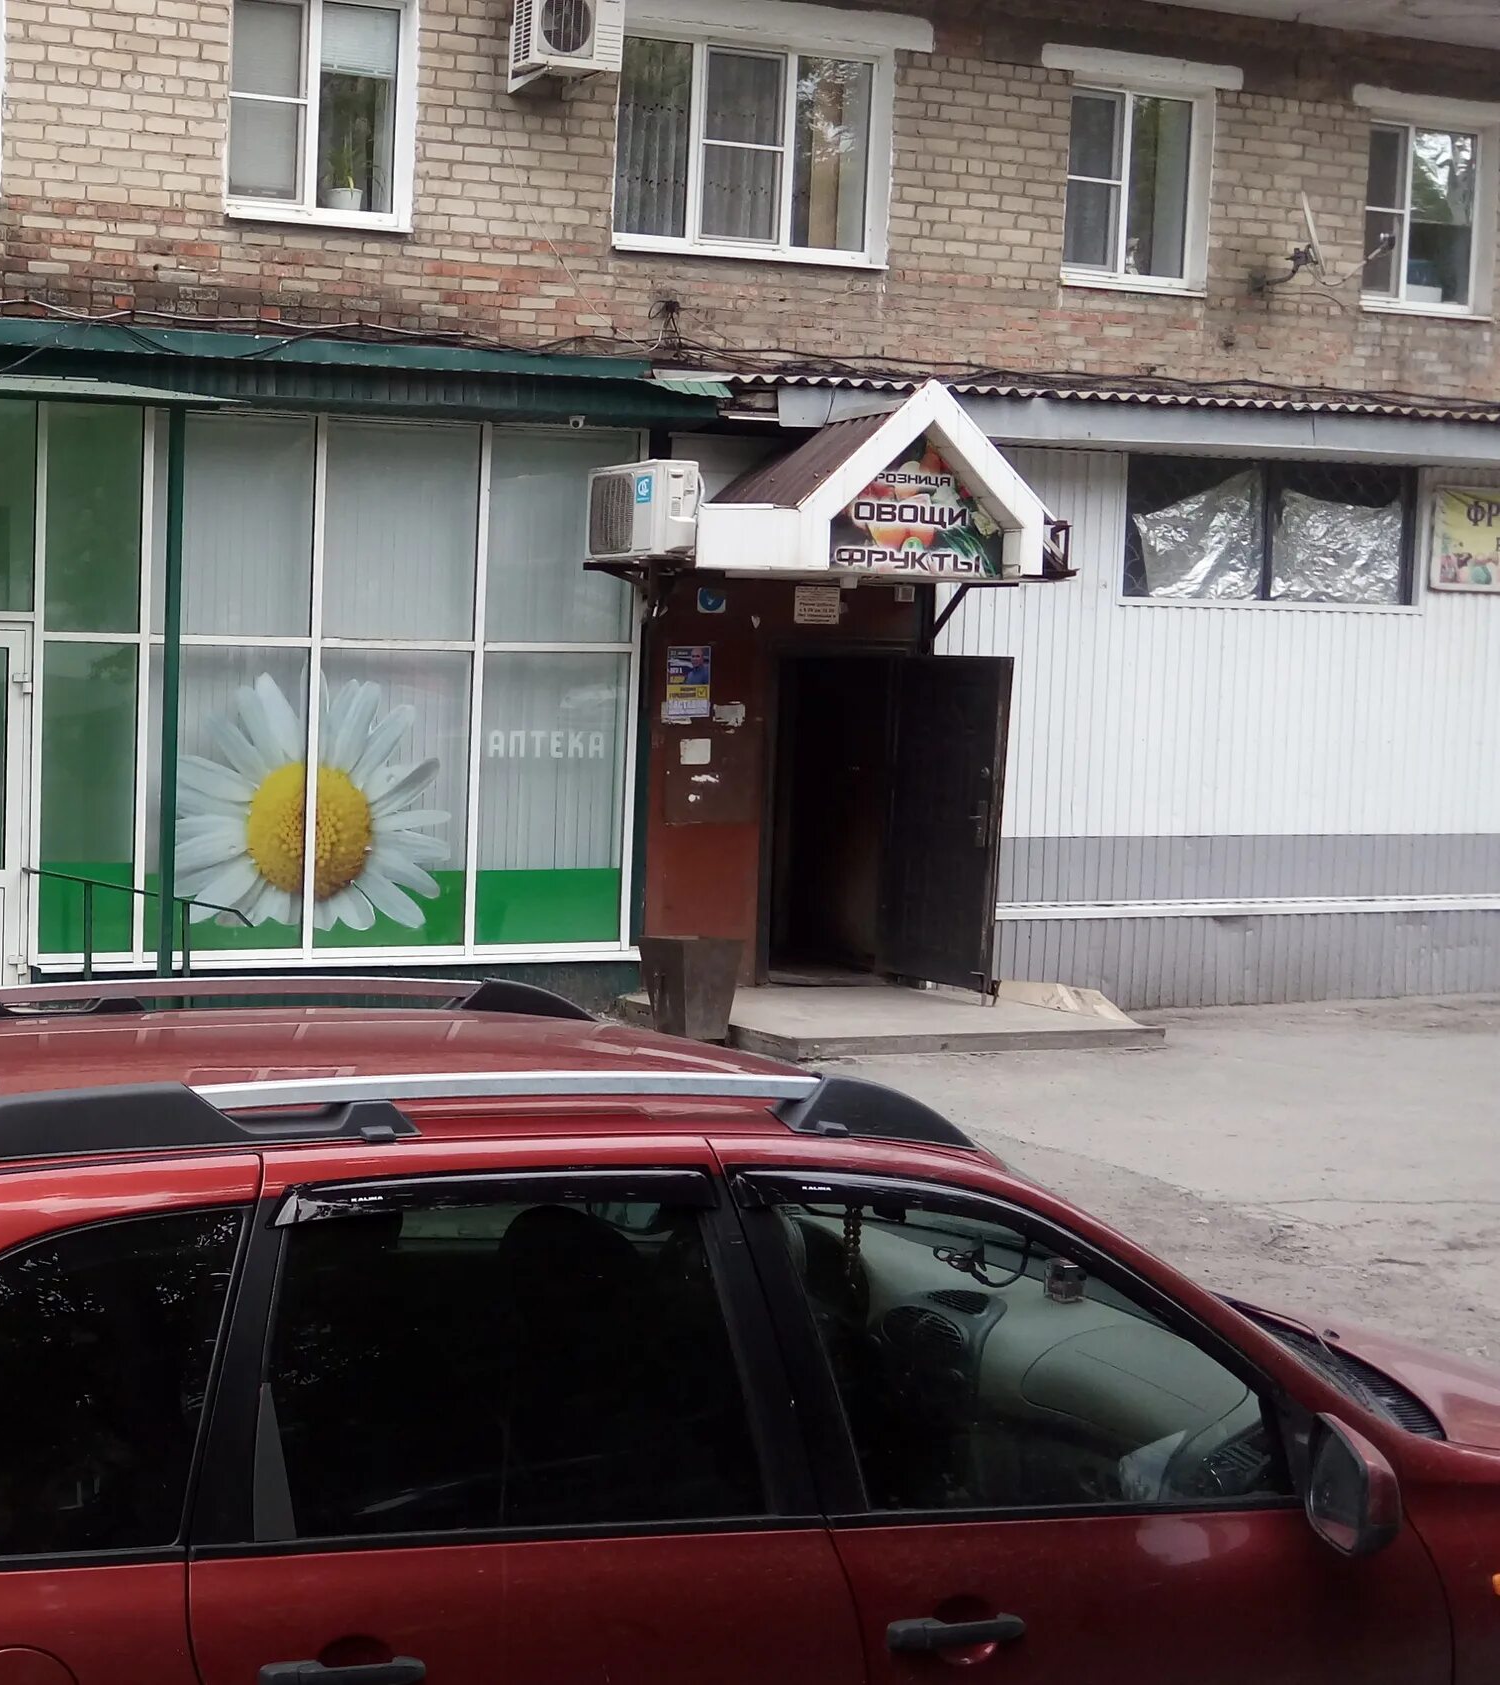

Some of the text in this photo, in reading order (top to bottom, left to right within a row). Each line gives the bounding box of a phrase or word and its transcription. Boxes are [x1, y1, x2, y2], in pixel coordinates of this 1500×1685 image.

[875, 472, 951, 487] РОЗНИЦА
[854, 501, 968, 529] ОВОЩИ
[836, 548, 981, 573] ФРУКТЫ
[488, 730, 604, 758] АПТЕКА
